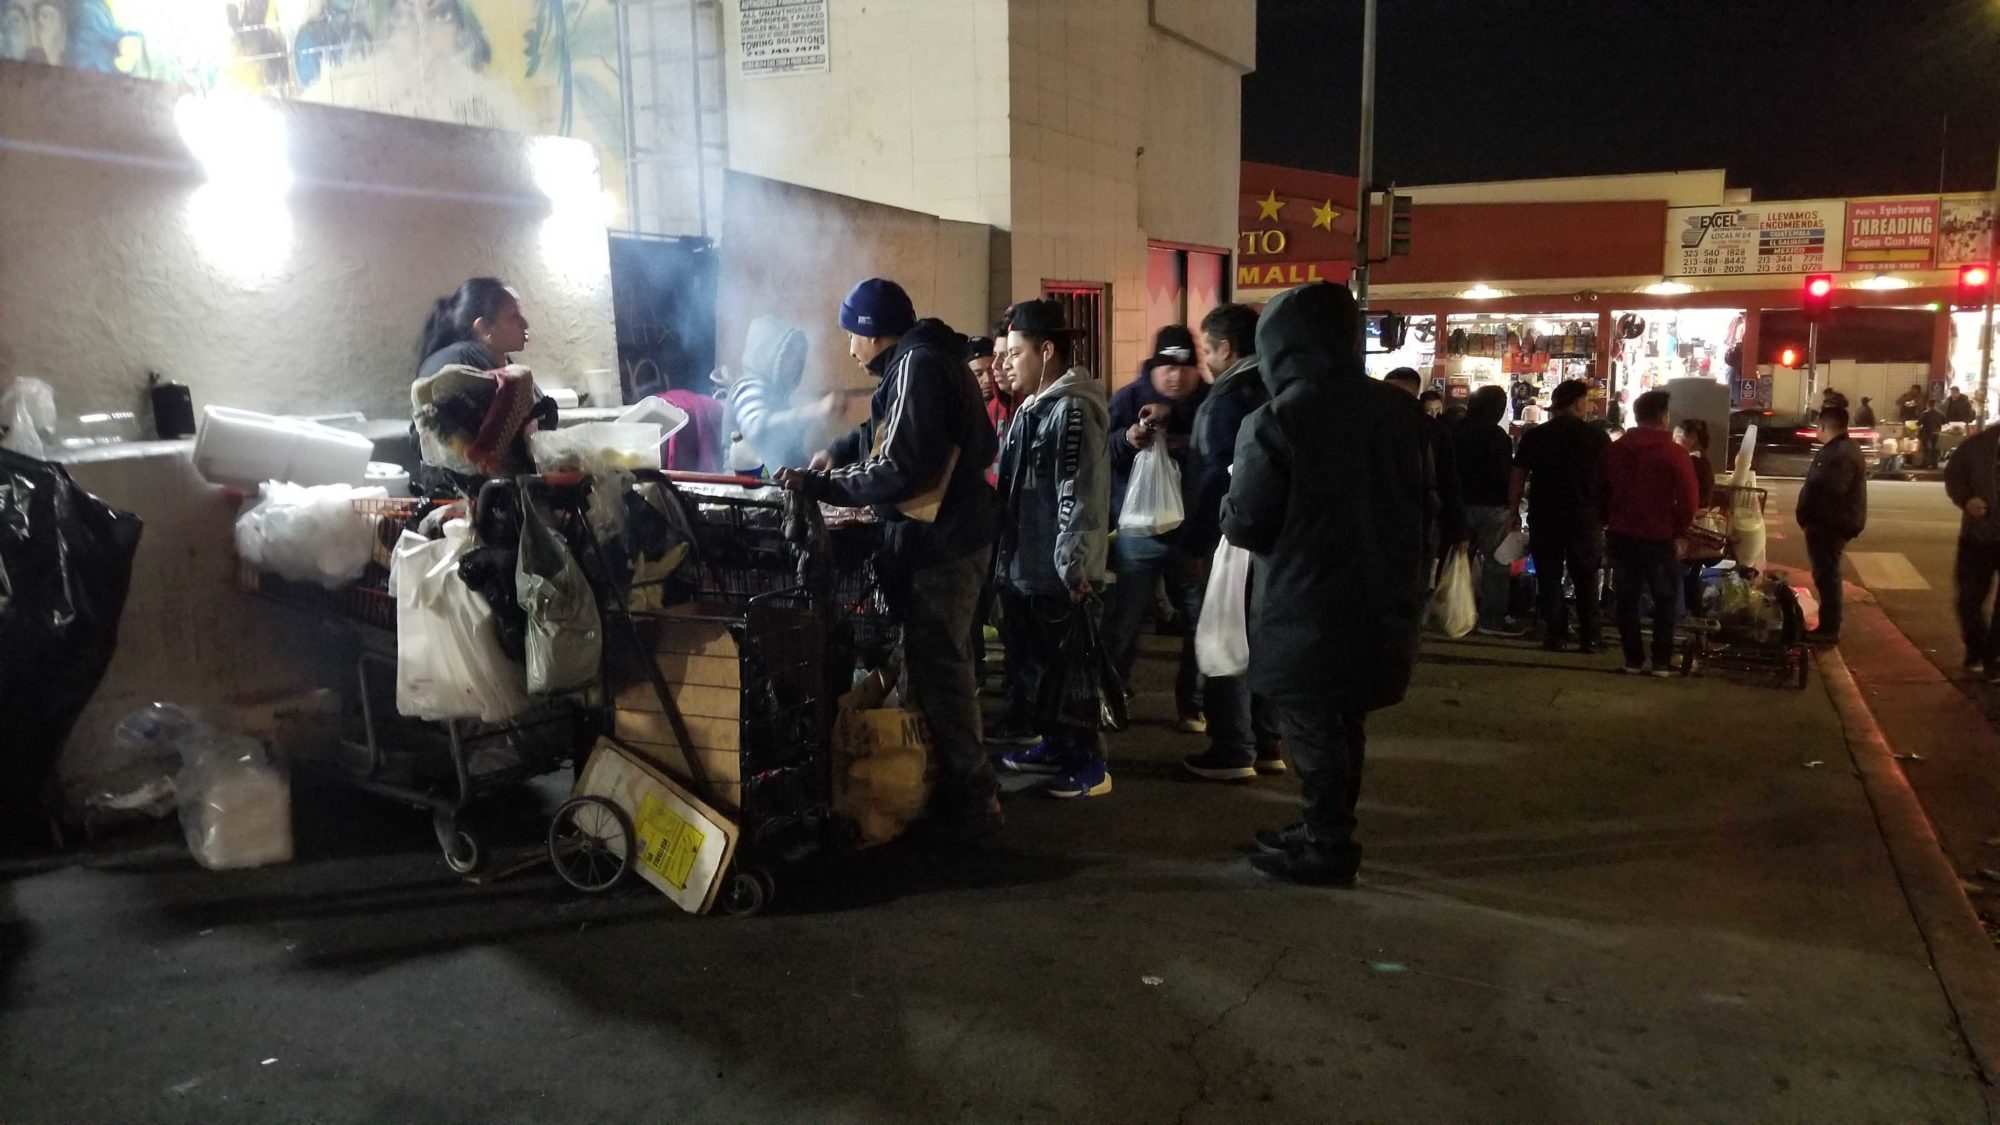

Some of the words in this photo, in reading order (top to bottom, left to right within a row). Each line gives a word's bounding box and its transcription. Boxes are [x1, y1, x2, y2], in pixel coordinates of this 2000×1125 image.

[759, 5, 822, 17] UNAUTHORIZED
[741, 40, 774, 52] TOWING
[776, 34, 825, 46] SOLUTIONS
[1767, 210, 1818, 221] LLEVAMOS
[1880, 205, 1931, 216] Eyebrows
[1700, 214, 1737, 229] EXCEL
[1760, 219, 1824, 230] ENCOMIENDAS
[1852, 217, 1933, 235] THREADING
[1711, 232, 1734, 240] LOCAL
[1769, 230, 1811, 238] GUATEMALA
[1238, 230, 1286, 255] TO
[1909, 236, 1930, 246] Hilo
[1238, 265, 1323, 285] MALL
